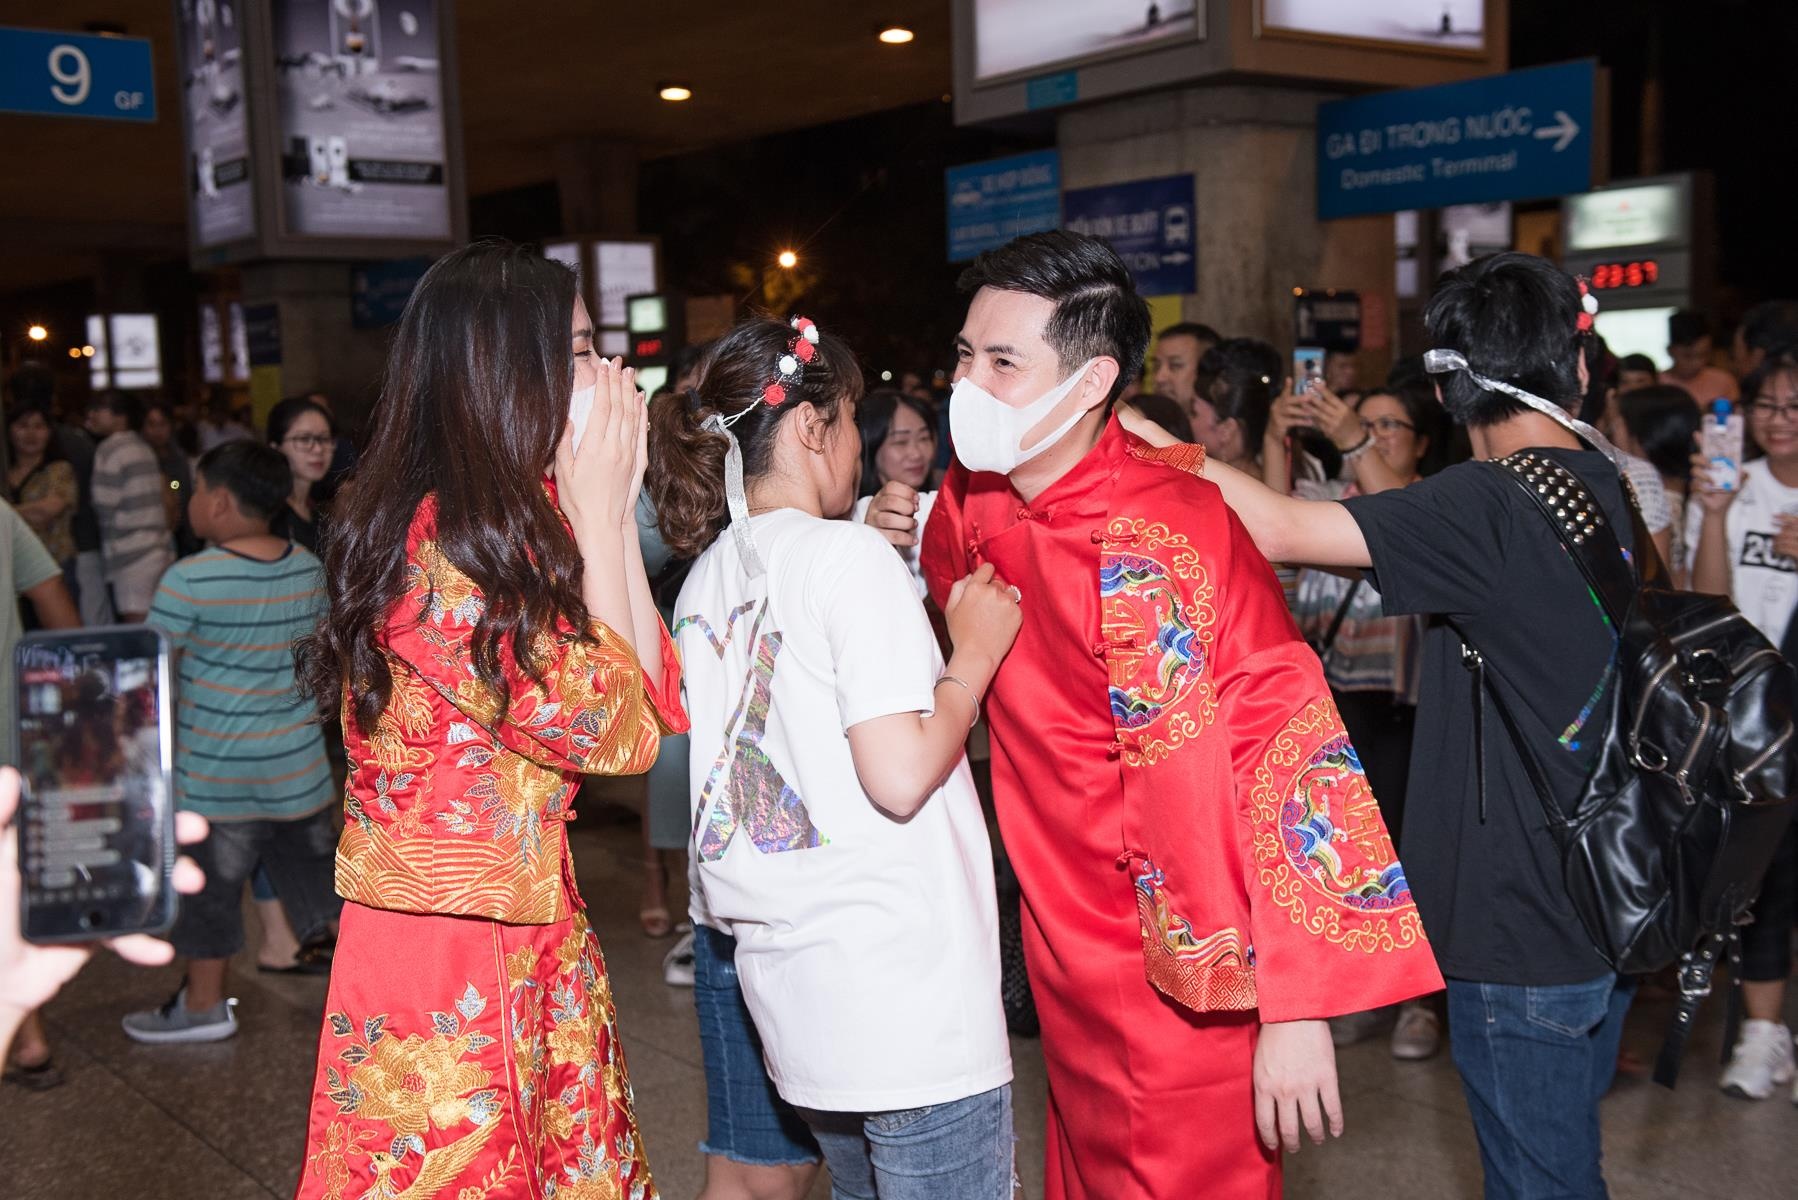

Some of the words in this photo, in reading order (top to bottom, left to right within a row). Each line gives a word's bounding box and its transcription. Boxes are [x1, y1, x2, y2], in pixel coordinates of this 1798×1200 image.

[48, 44, 91, 105] 9
[114, 90, 144, 110] GF
[1326, 132, 1355, 159] GA
[1386, 117, 1461, 149] TRONG
[1465, 104, 1532, 140] NƯỚC
[1340, 163, 1425, 190] Domestic
[1431, 151, 1518, 178] Terminal
